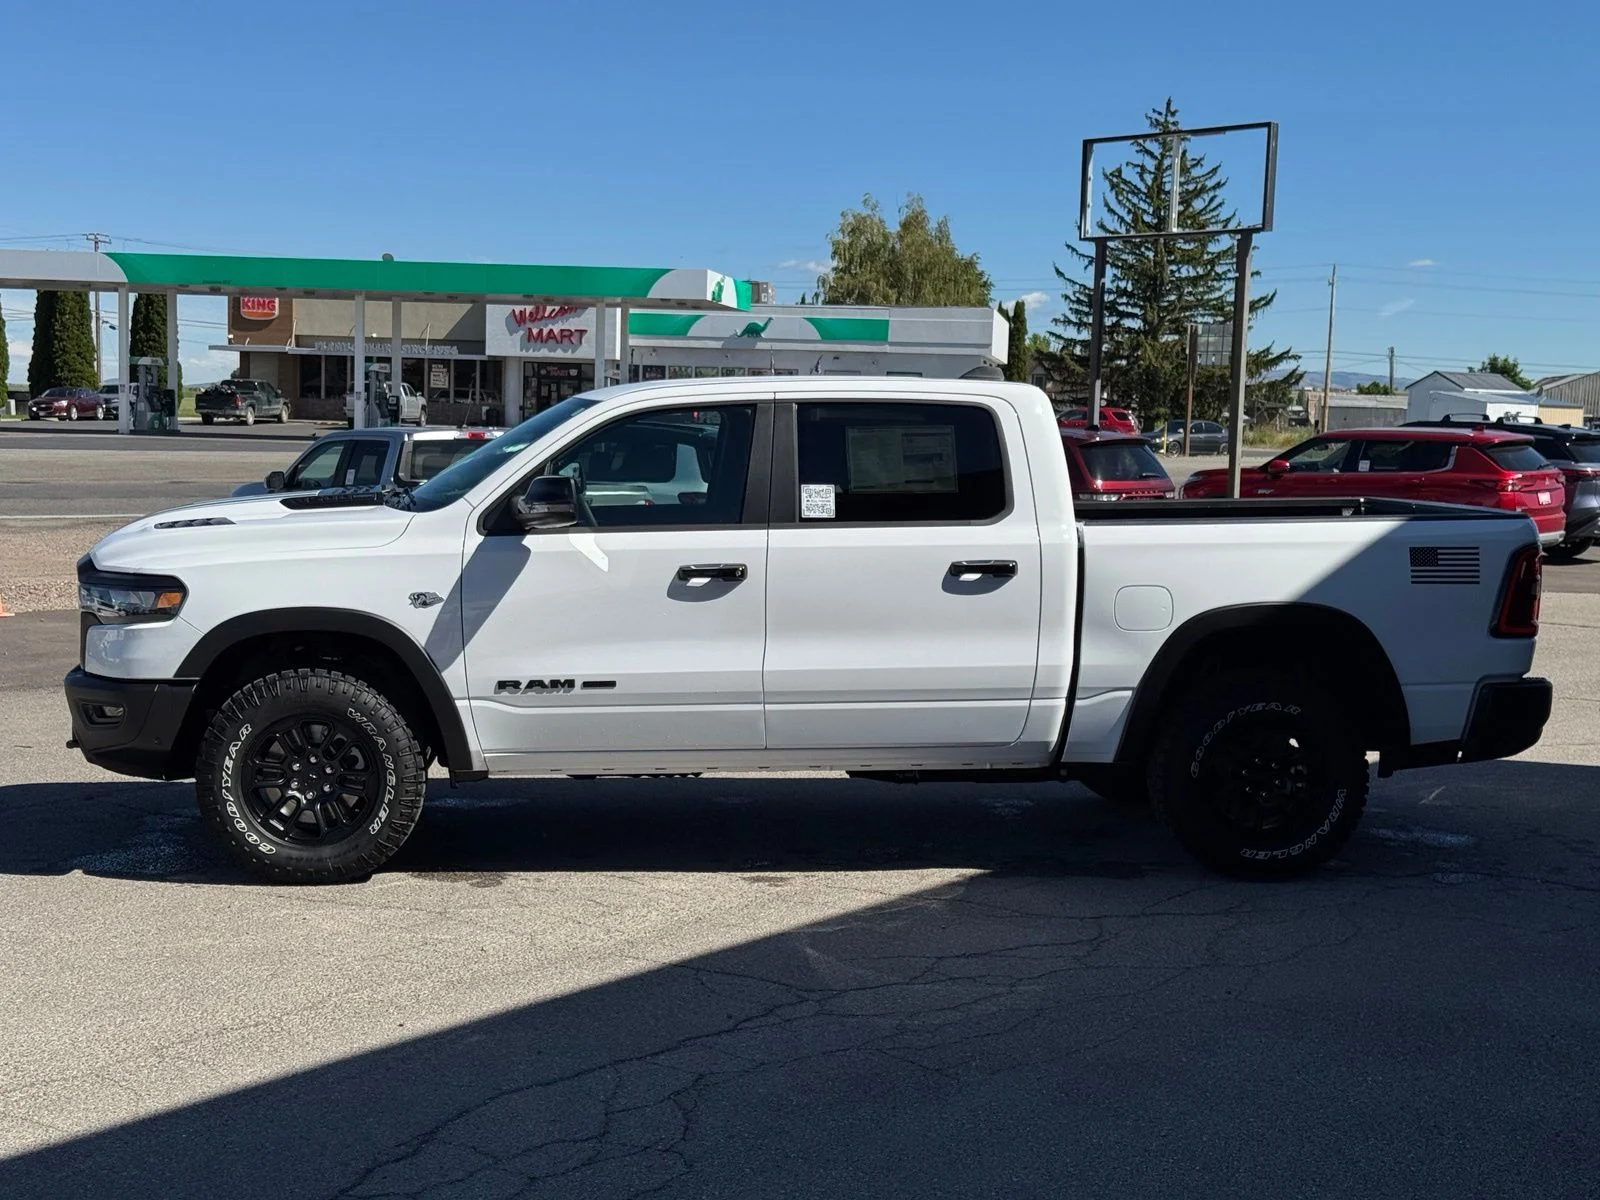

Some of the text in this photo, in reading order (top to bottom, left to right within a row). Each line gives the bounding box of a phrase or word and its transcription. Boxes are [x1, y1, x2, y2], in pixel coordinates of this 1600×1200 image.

[242, 298, 276, 312] KING
[512, 303, 579, 327] Welcom
[527, 327, 588, 346] MART
[497, 679, 575, 690] RAM
[1191, 702, 1301, 778] GOODYEAR
[221, 723, 276, 854] GOODYEAR
[346, 708, 397, 835] WRANGLER
[1240, 789, 1347, 860] WRANGLER
